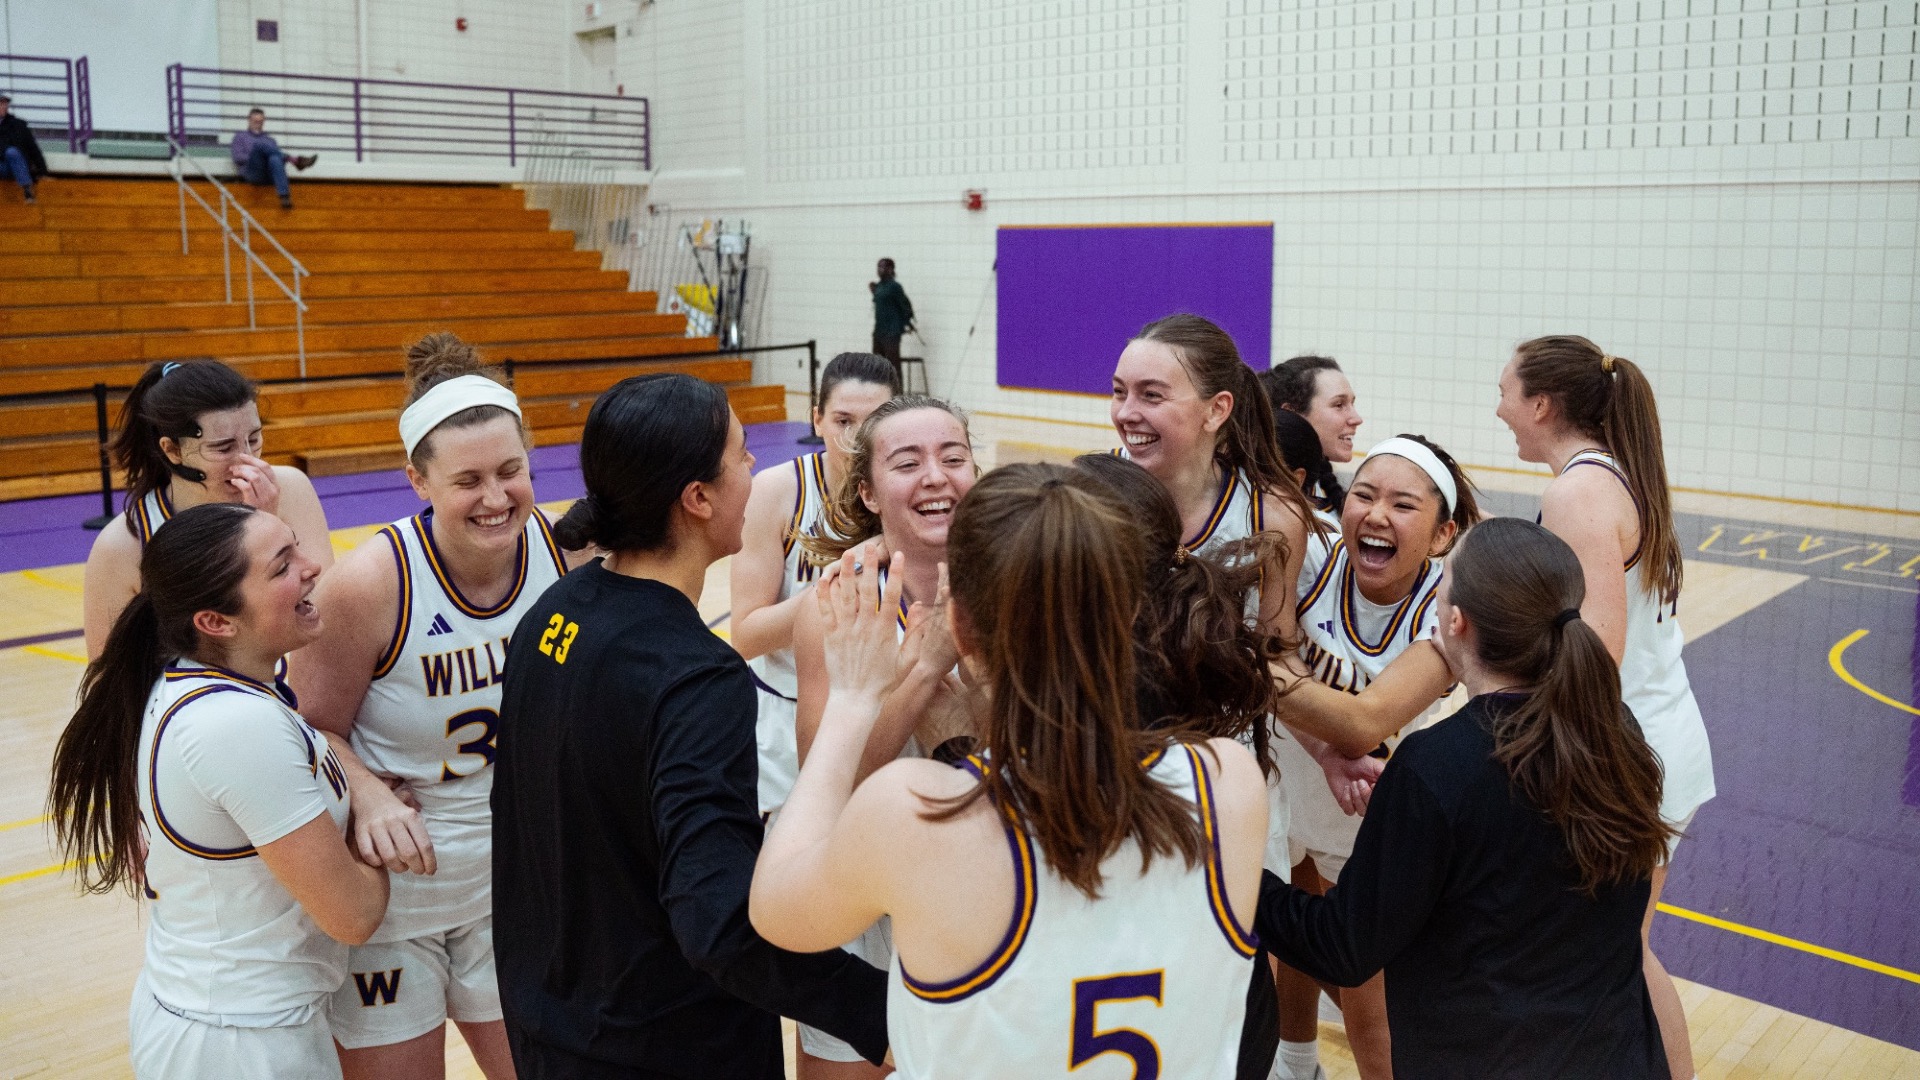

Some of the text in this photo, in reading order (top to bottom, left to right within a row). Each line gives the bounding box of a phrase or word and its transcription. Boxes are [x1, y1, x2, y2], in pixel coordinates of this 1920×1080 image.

[419, 637, 509, 698] WILL
[538, 612, 580, 665] 23
[1304, 638, 1372, 696] WILL
[440, 706, 499, 783] 3
[352, 967, 404, 1008] W
[1068, 968, 1165, 1080] 5
